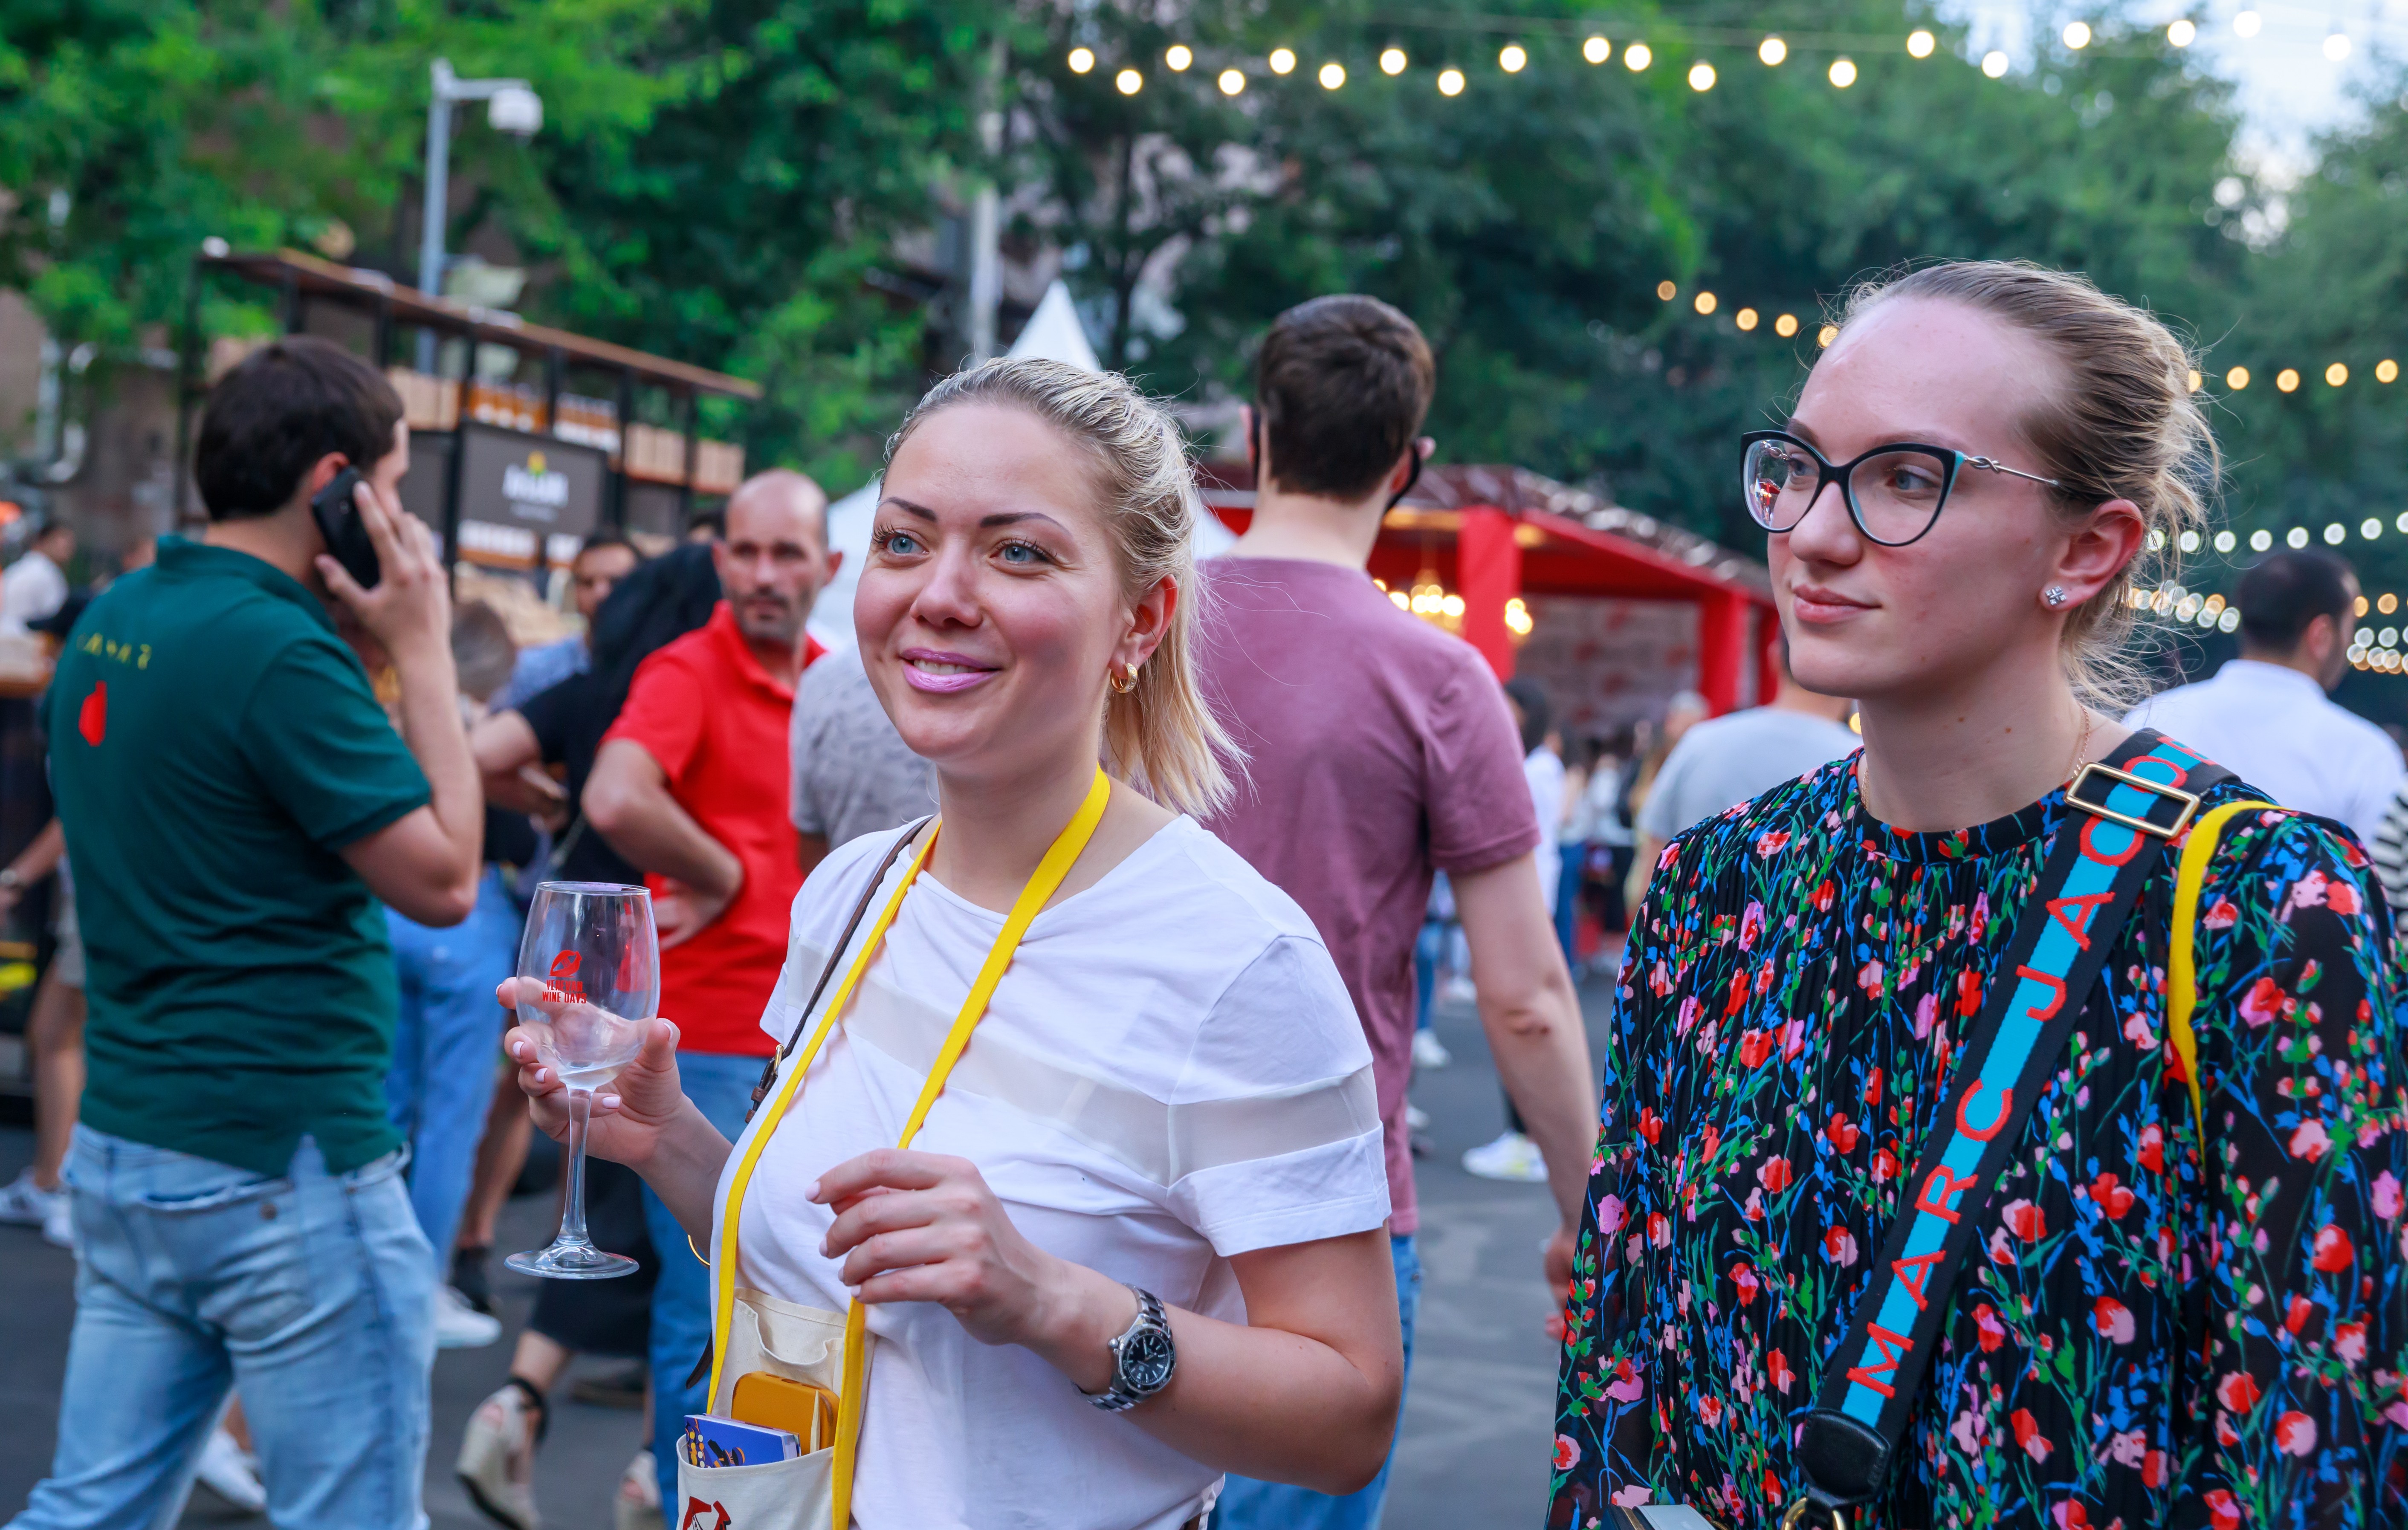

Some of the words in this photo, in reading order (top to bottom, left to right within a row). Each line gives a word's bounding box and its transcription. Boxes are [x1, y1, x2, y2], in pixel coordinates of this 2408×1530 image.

[546, 979, 583, 992] YEREVAN
[542, 991, 561, 1003] WINE
[564, 992, 587, 1004] DAYS
[1847, 1079, 2013, 1399] MARC
